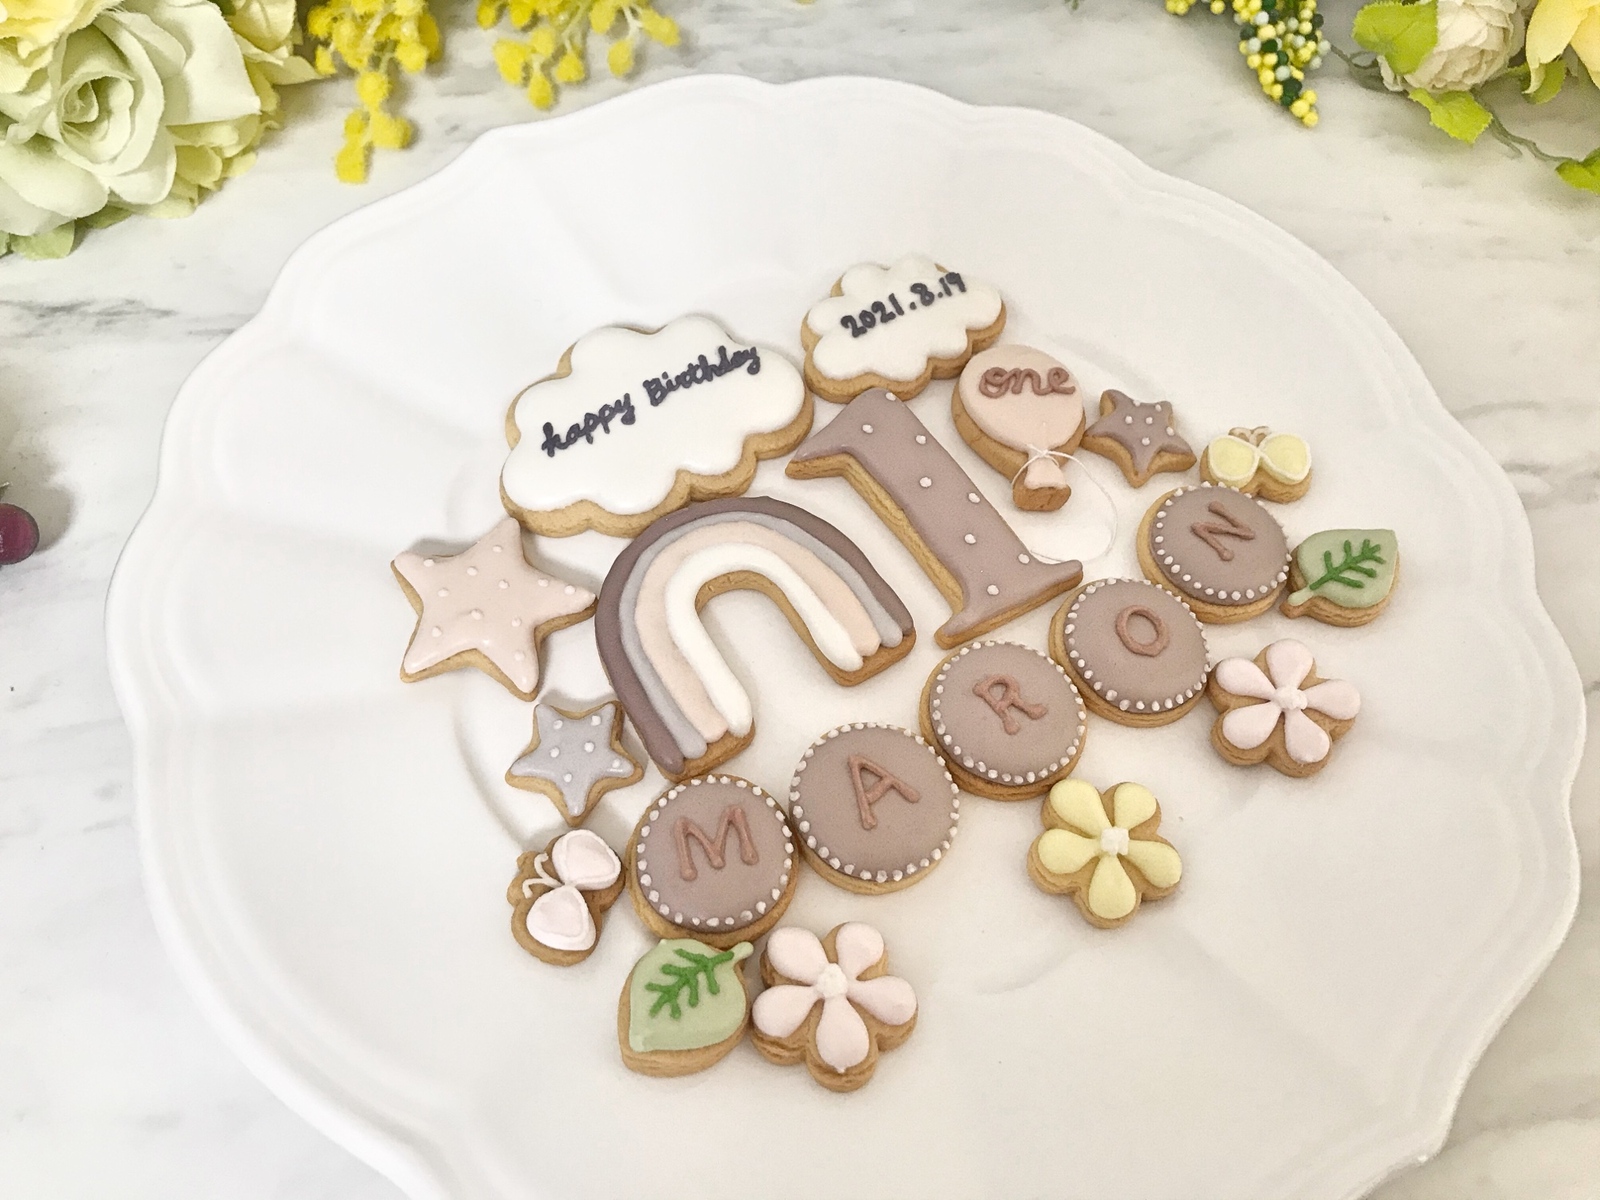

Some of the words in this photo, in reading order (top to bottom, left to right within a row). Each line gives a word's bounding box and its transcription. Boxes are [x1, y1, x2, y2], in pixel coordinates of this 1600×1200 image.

[840, 271, 967, 338] 2021.8.19
[541, 393, 636, 457] happy
[643, 345, 761, 407] Birthday
[978, 366, 1076, 399] one
